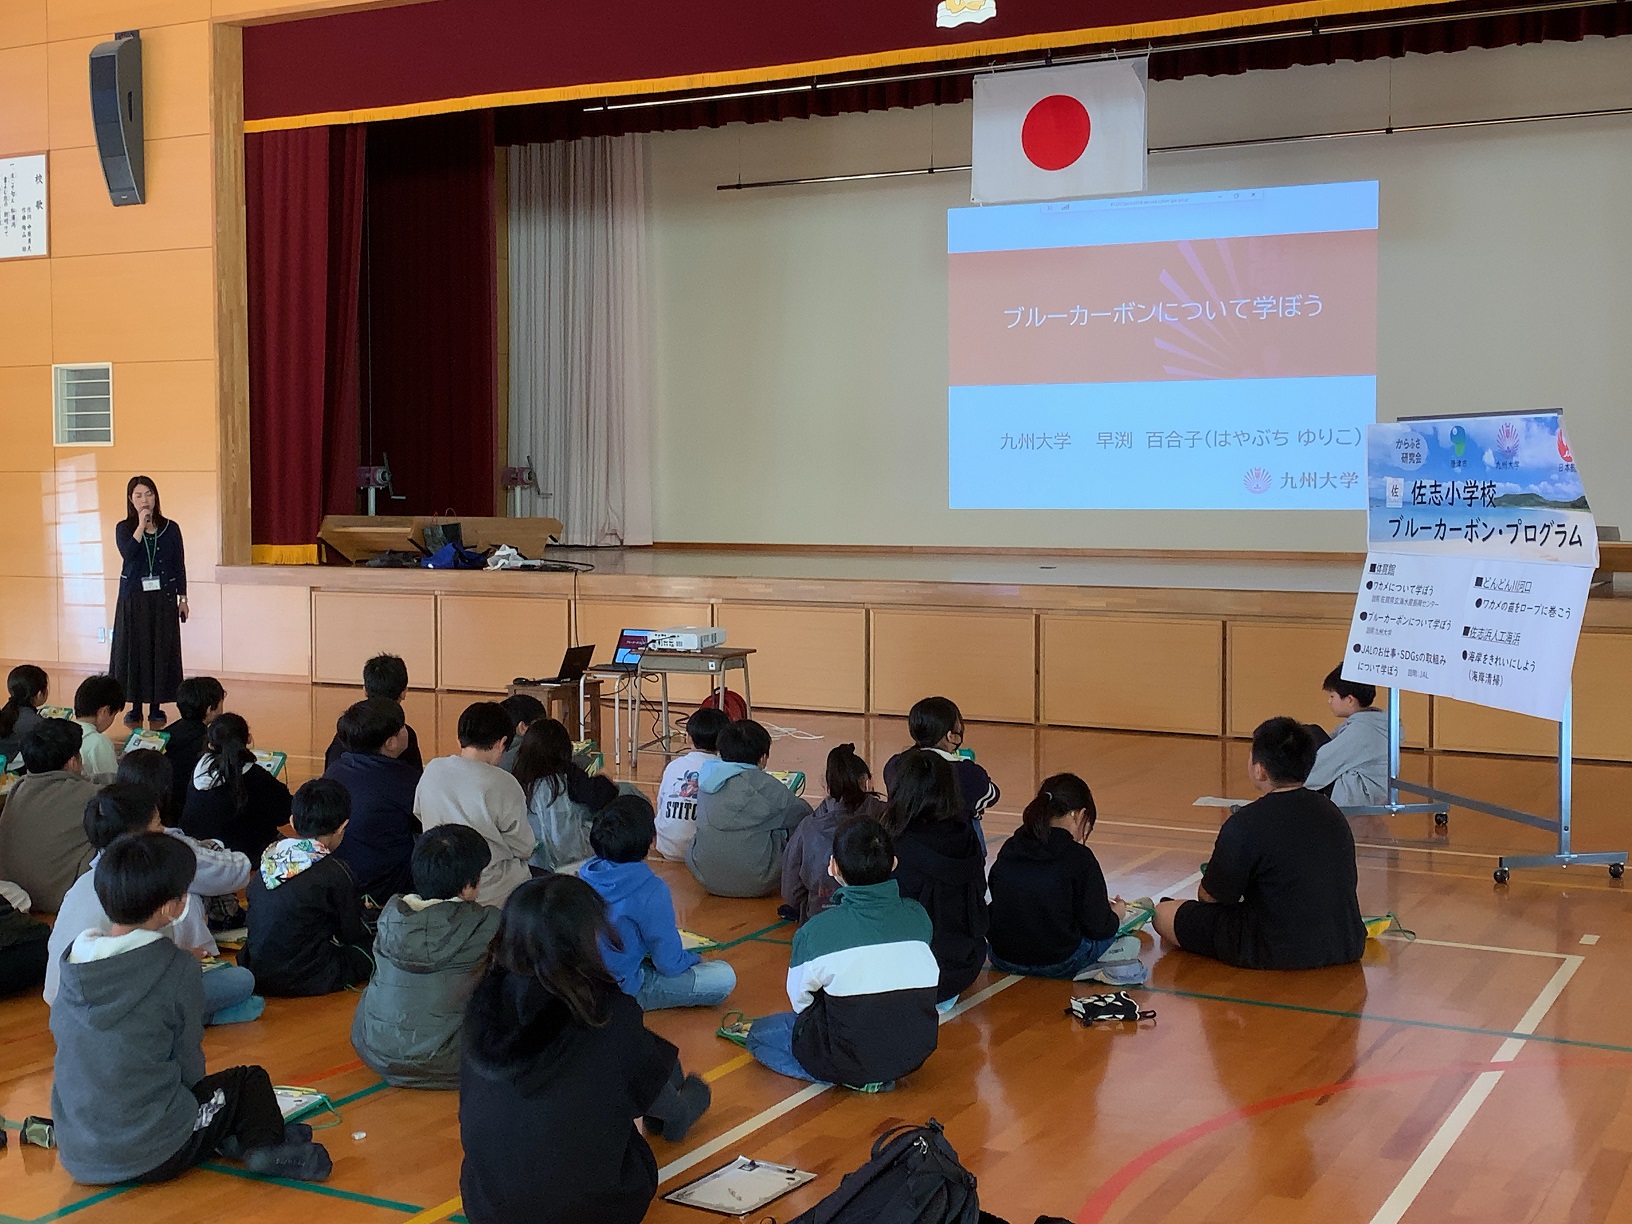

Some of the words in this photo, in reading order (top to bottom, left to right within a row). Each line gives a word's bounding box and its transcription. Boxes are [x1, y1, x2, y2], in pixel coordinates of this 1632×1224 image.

[1003, 293, 1324, 329] ブルーカーボンについて学ぼう
[1000, 432, 1072, 450] 九州大学
[1401, 452, 1422, 464] 研究会
[1496, 461, 1519, 470] 九州大学
[1279, 471, 1359, 489] 九州大学
[1411, 481, 1496, 508] 佐志小学校
[1389, 517, 1583, 547] ブルーカーボン・プログラム
[1373, 582, 1434, 596] ワカメについて学ぼう
[1483, 577, 1532, 593] どんどん川河口
[1483, 600, 1571, 620] ワカメの苗をロープに巻こう
[1368, 612, 1452, 630] ブルーカーボンについて学ぼう
[1470, 627, 1521, 646] 佐志浜人工海浜
[1358, 662, 1398, 676] について学ぼう
[1468, 651, 1536, 672] 海岸をきれいにしよう
